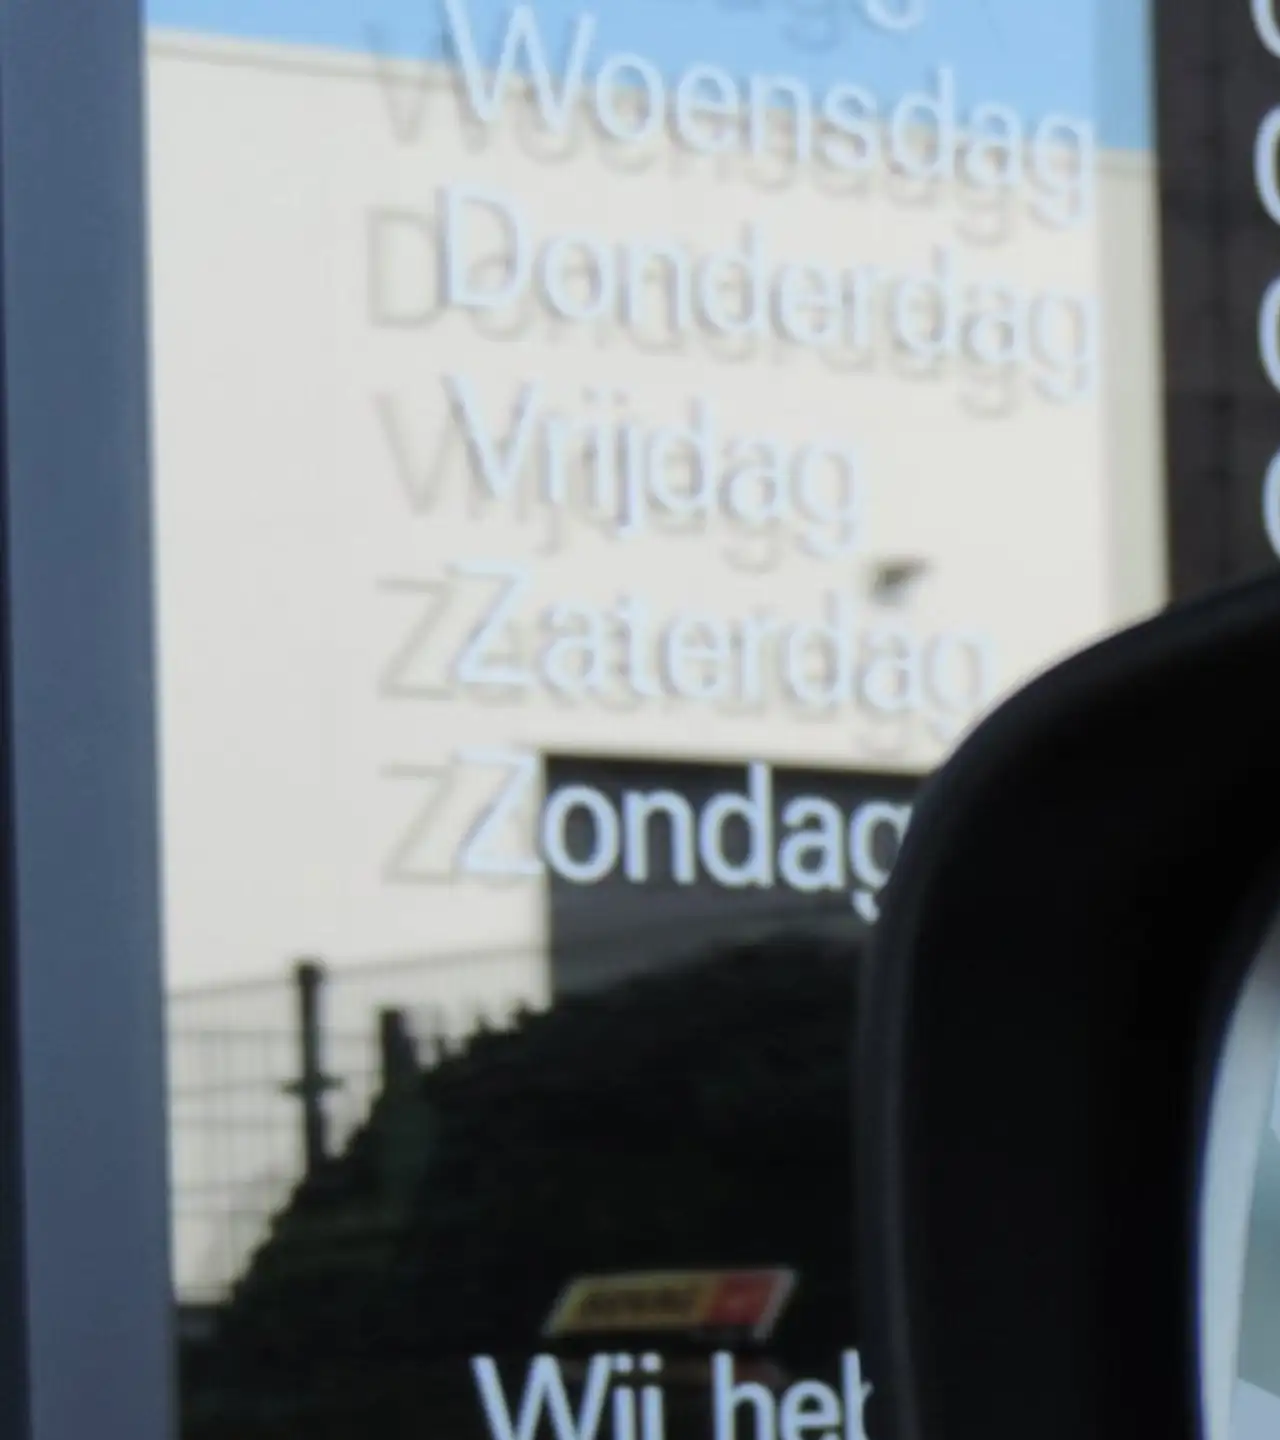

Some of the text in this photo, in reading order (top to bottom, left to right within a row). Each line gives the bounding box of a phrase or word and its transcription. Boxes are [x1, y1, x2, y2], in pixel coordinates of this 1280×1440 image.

[446, 0, 1098, 231] Woensdag
[438, 181, 1100, 399] Donderdag
[444, 370, 866, 560] Vrijdag
[450, 557, 998, 742] Zaterdag
[456, 748, 916, 924] Zondag
